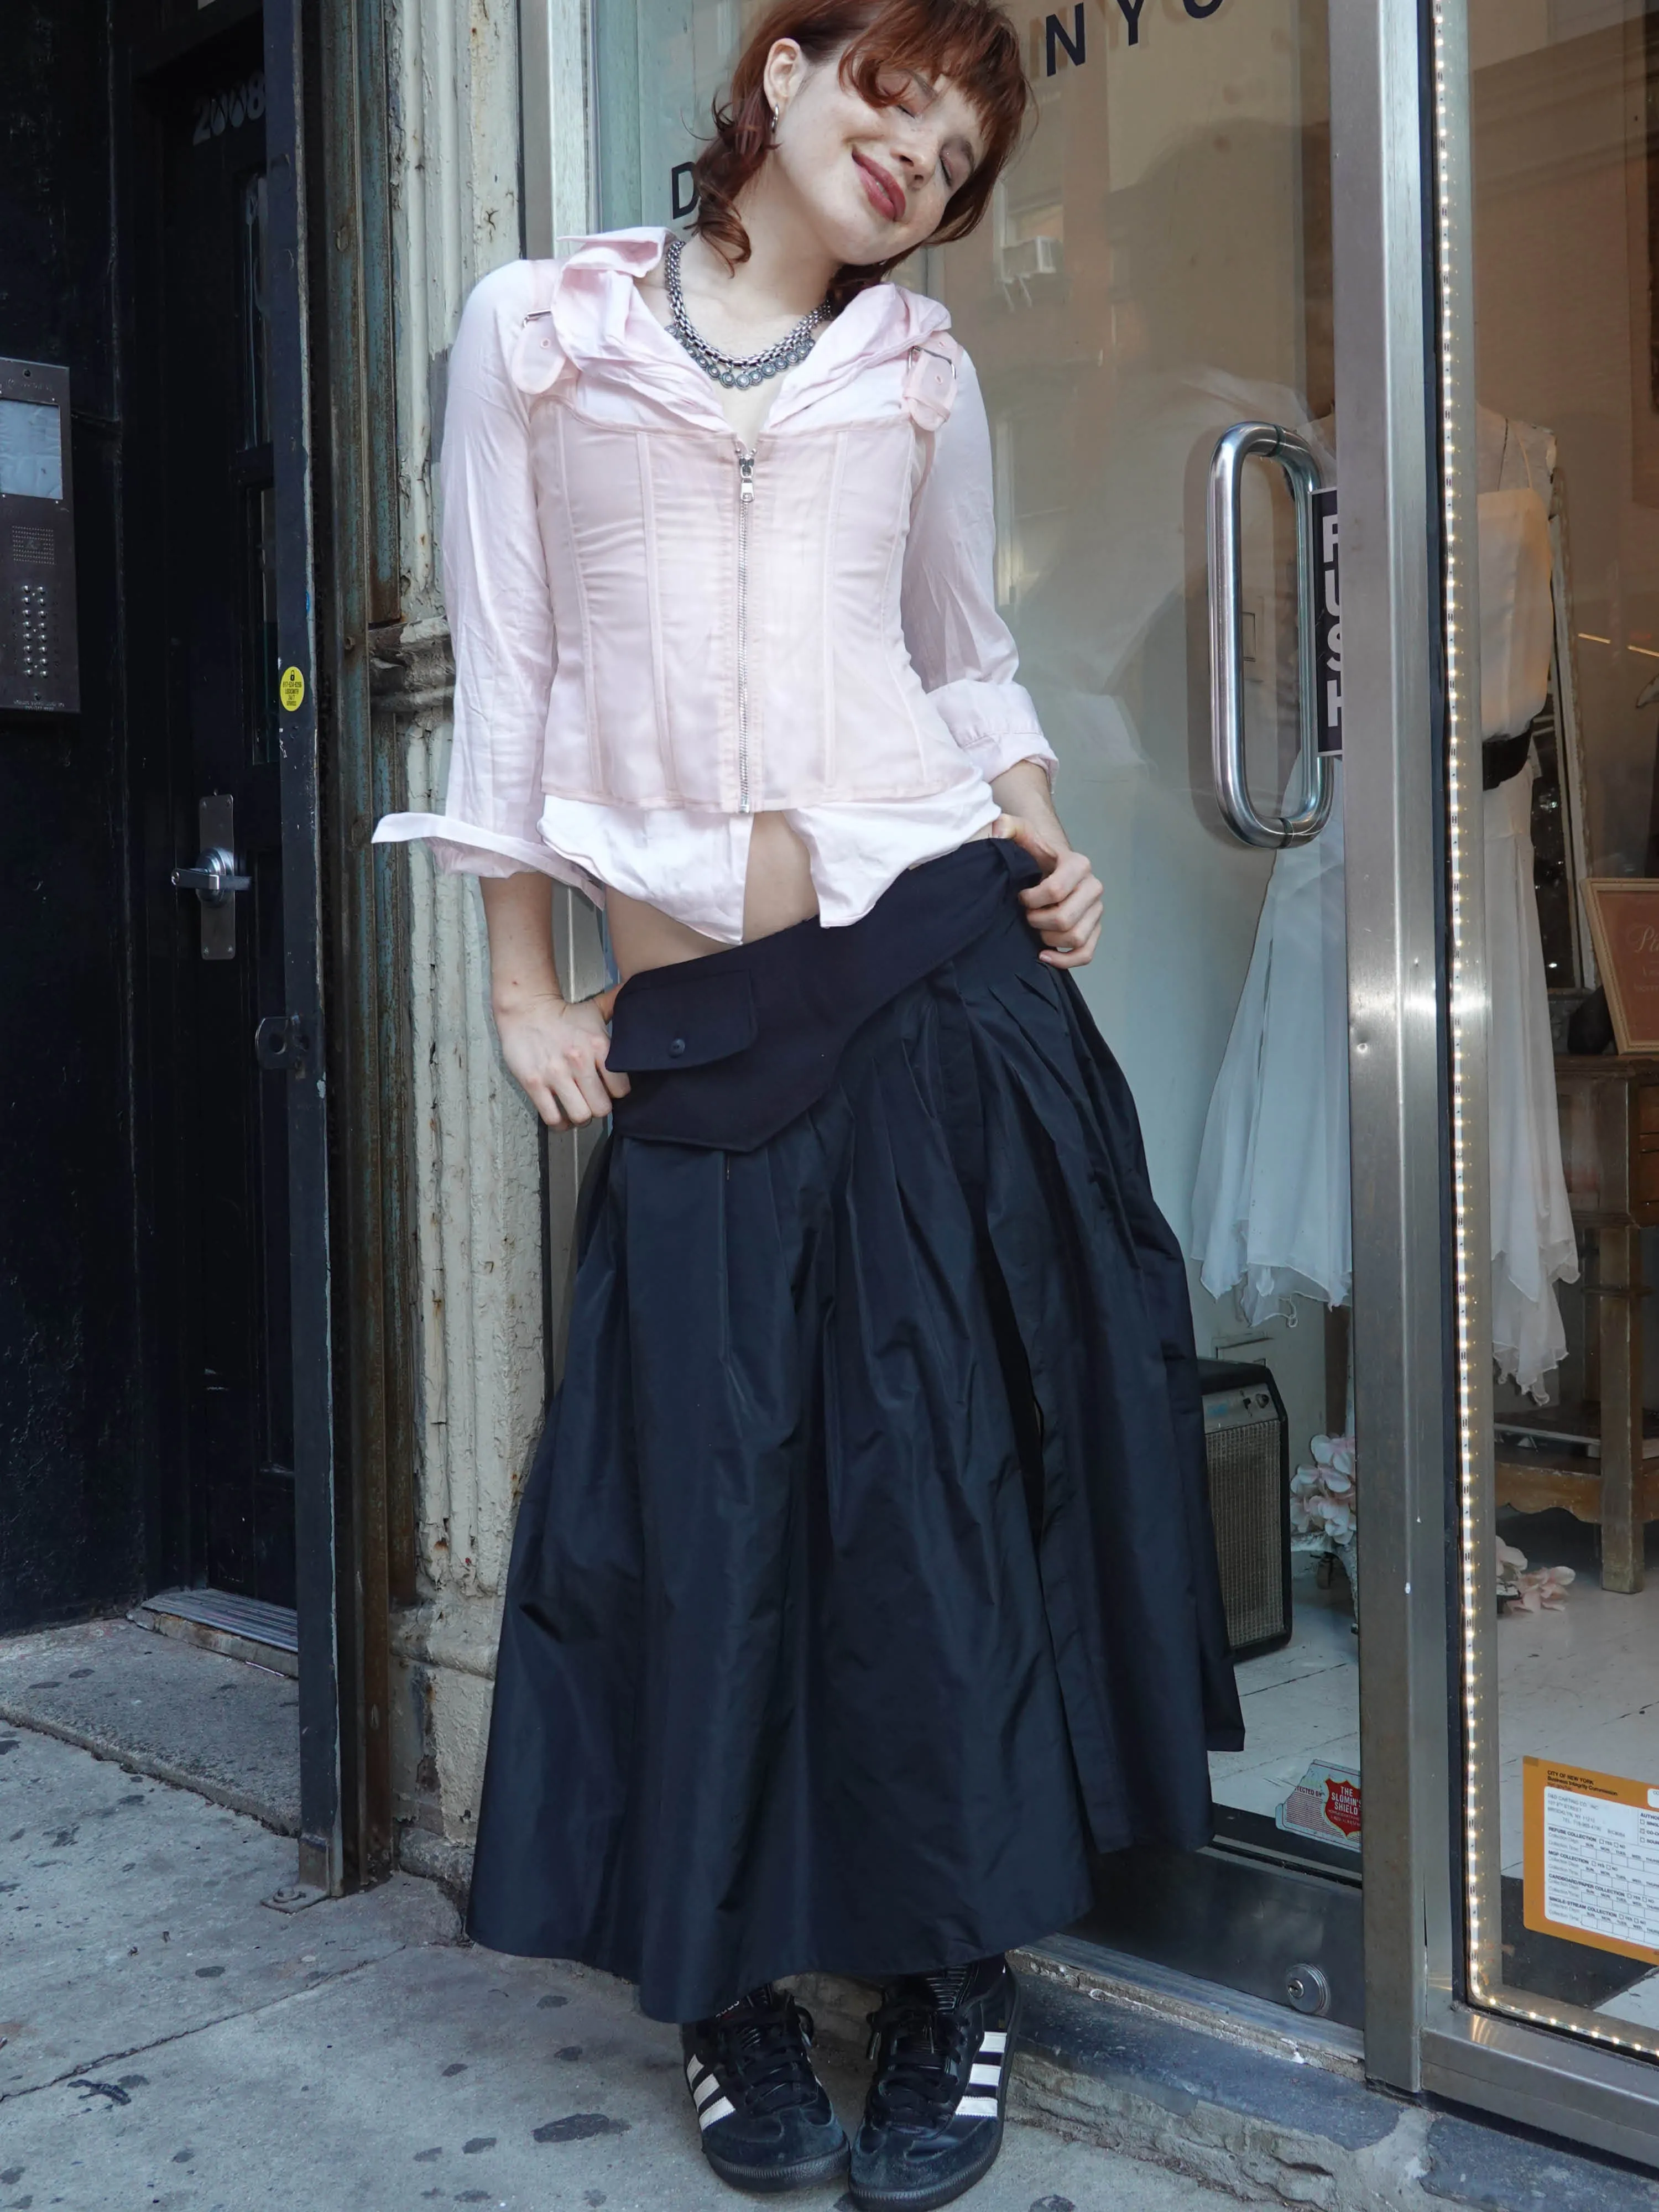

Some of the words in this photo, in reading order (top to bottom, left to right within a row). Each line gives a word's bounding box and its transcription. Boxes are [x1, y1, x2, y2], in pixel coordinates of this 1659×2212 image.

[1046, 0, 1222, 77] NY
[1340, 1786, 1353, 1796] THE
[1547, 1775, 1567, 1785] Business
[1568, 1780, 1587, 1790] Integrity
[1588, 1785, 1618, 1797] Commission
[1334, 1801, 1358, 1815] SHIELD
[1564, 1803, 1582, 1812] STREET
[1548, 1826, 1566, 1834] REFUSE
[1567, 1831, 1596, 1842] COLLECTION
[1548, 1832, 1567, 1841] Collection
[1559, 1853, 1588, 1864] COLLECTION
[1548, 1873, 1593, 1889] CARDBOARD/PAPER
[1595, 1885, 1624, 1897] COLLECTION
[1587, 1906, 1616, 1917] COLLECTION
